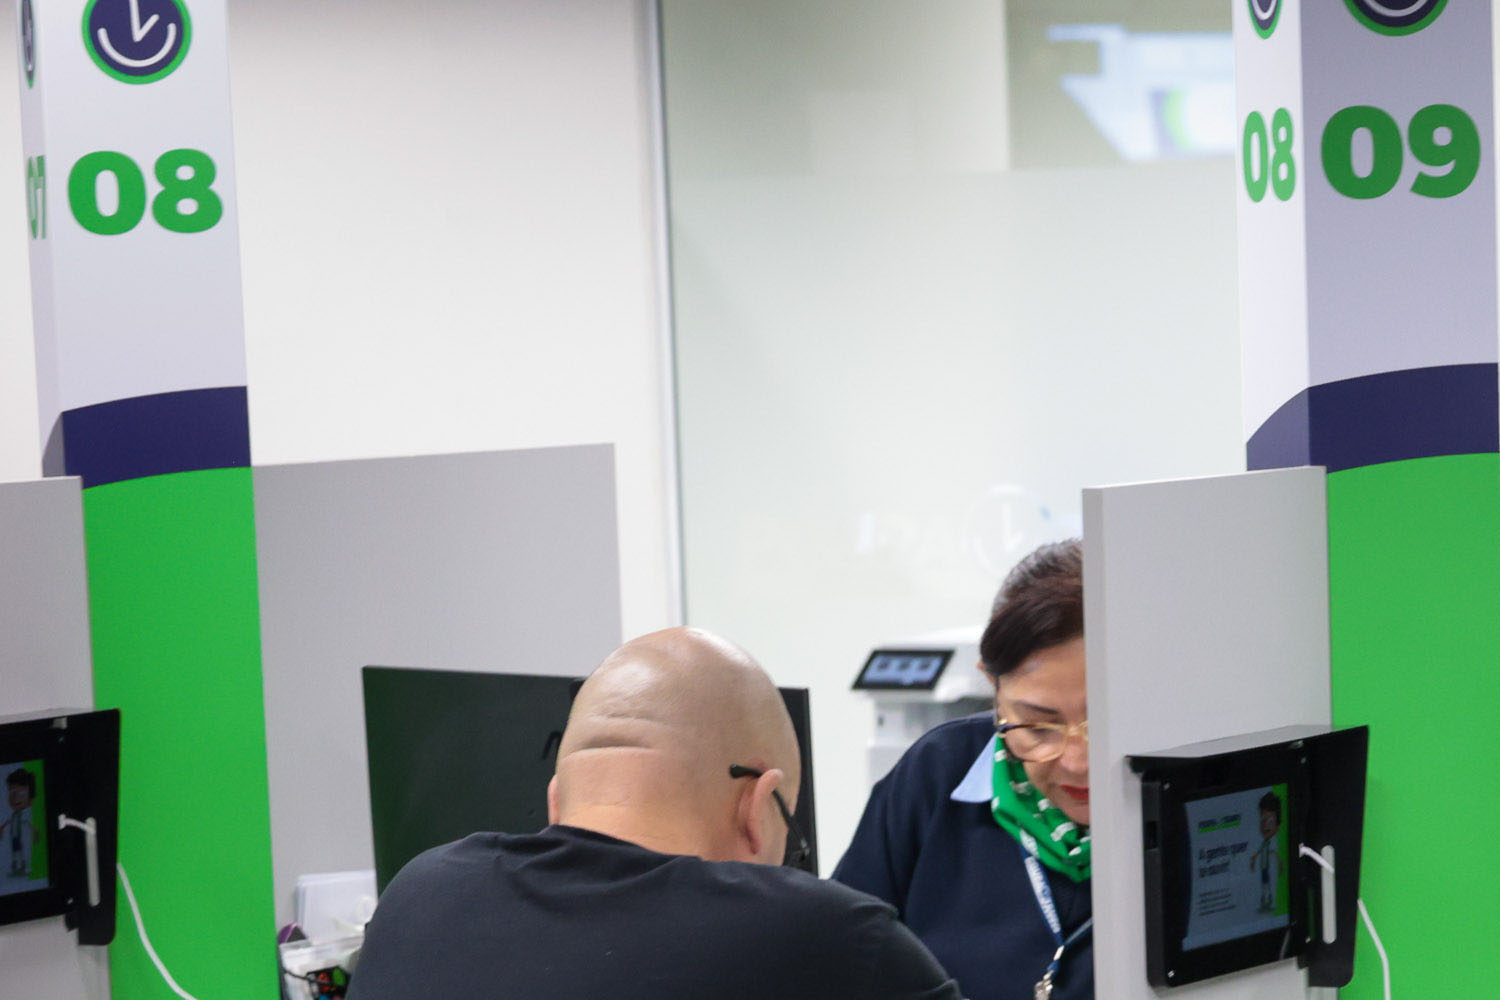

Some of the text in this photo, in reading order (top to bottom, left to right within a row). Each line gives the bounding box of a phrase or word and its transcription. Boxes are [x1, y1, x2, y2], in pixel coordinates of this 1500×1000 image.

[68, 148, 223, 235] 08
[1243, 107, 1295, 202] 08
[1321, 104, 1481, 199] 09
